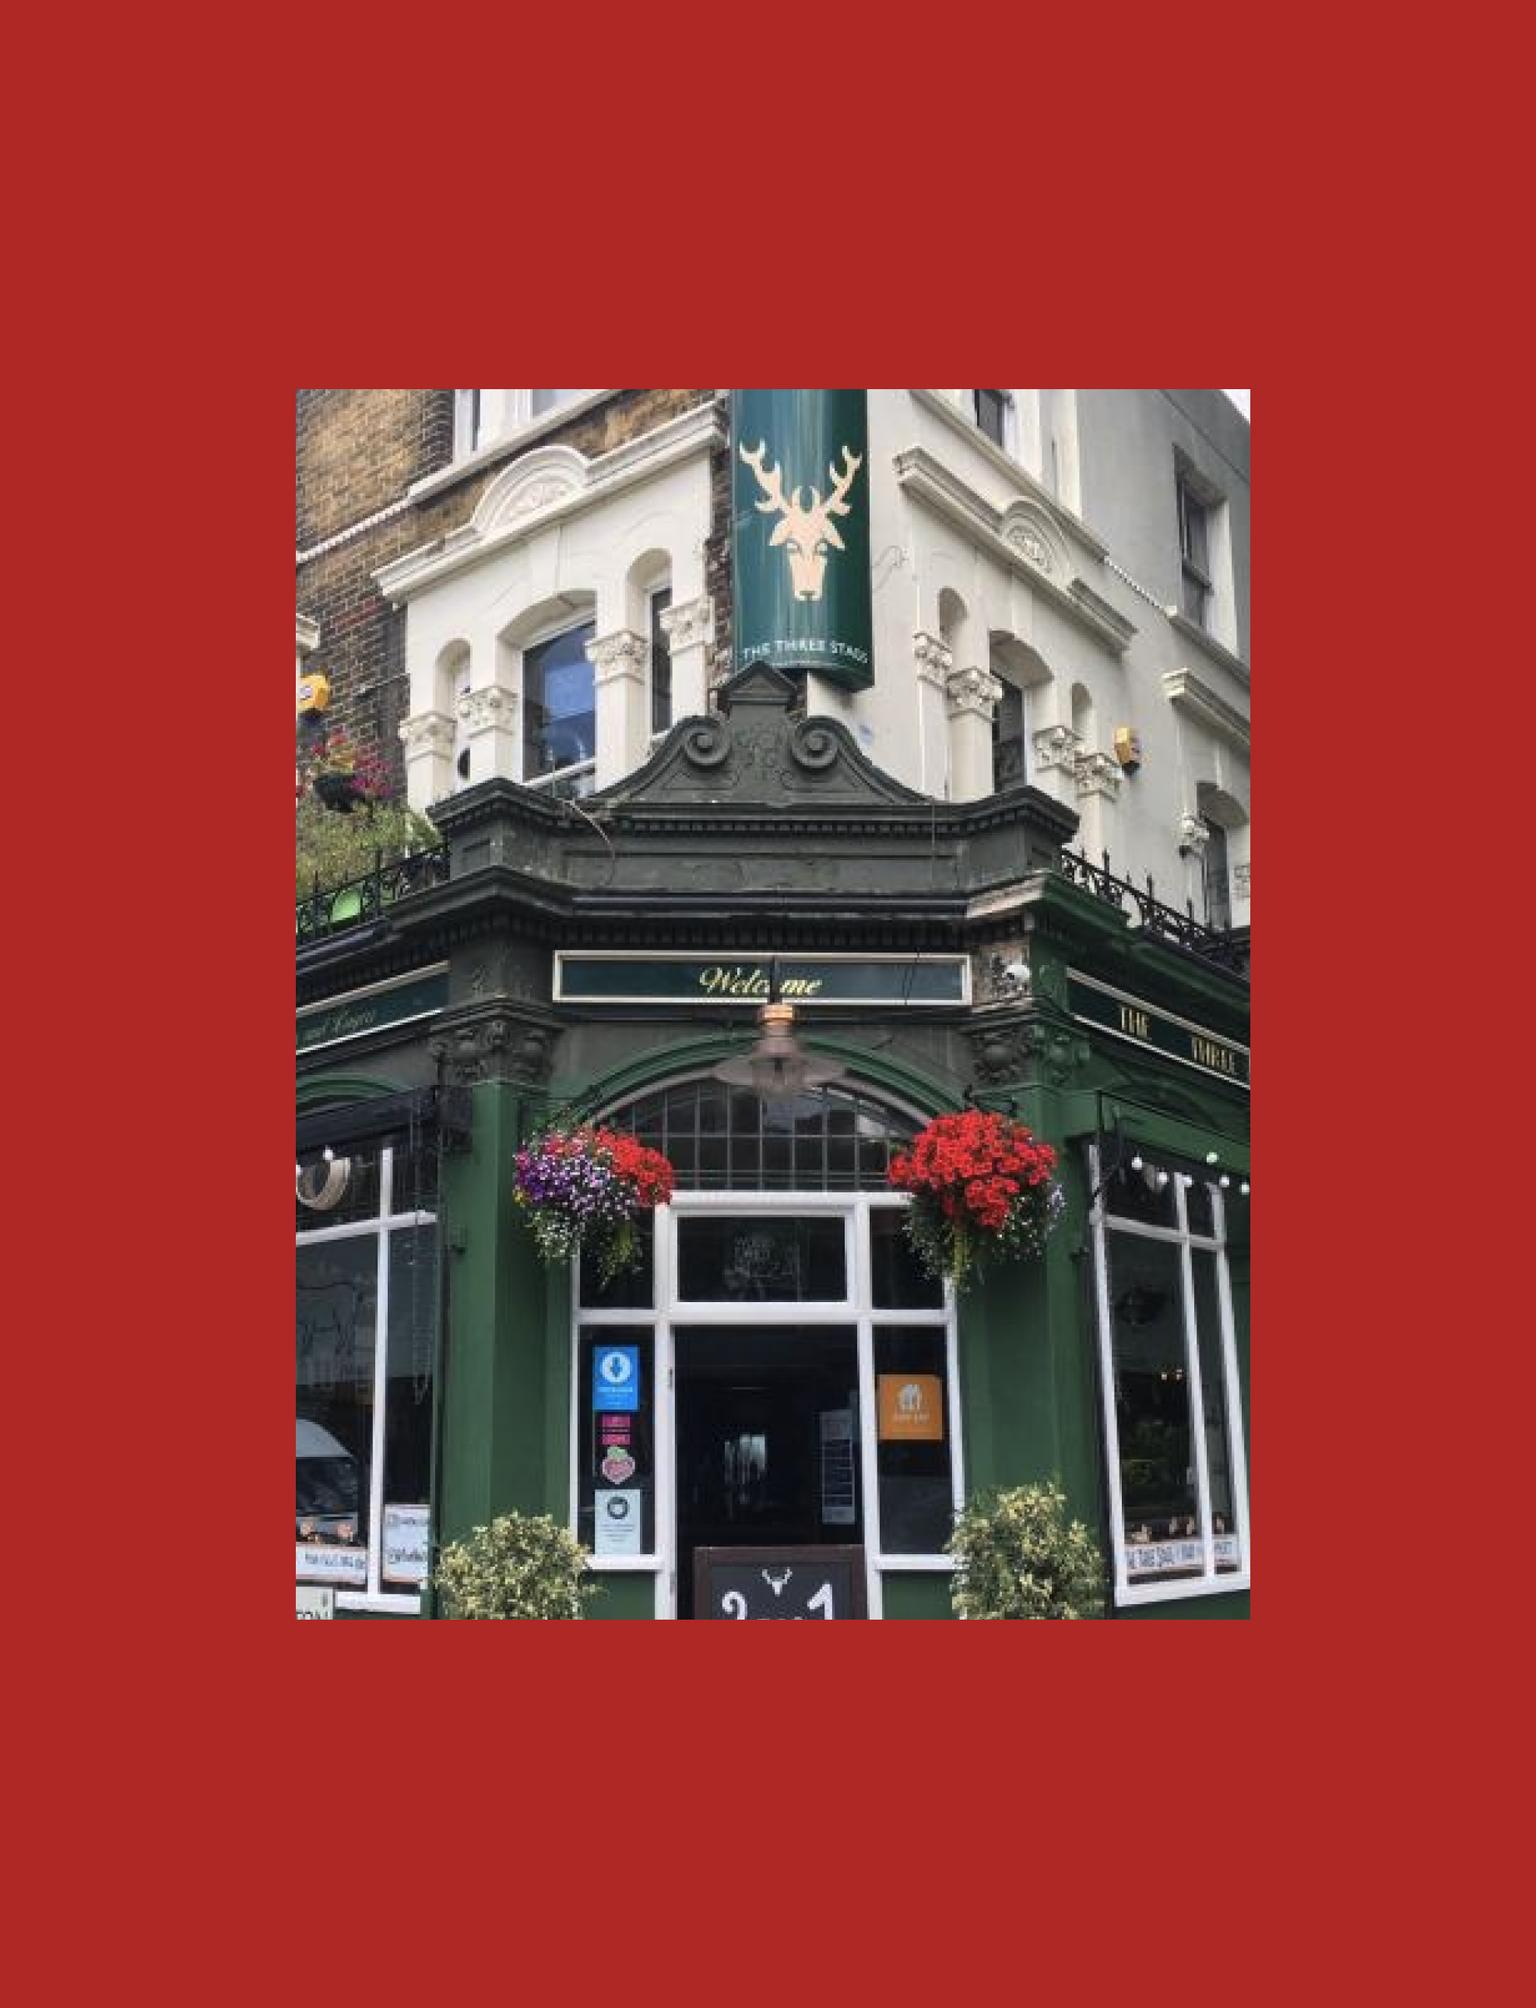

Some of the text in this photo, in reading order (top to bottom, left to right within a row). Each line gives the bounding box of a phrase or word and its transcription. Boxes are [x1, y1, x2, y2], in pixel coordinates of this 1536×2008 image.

[742, 639, 869, 664] THE THREE STAGS
[699, 966, 823, 995] Welcme
[1120, 1005, 1237, 1076] THE THREE
